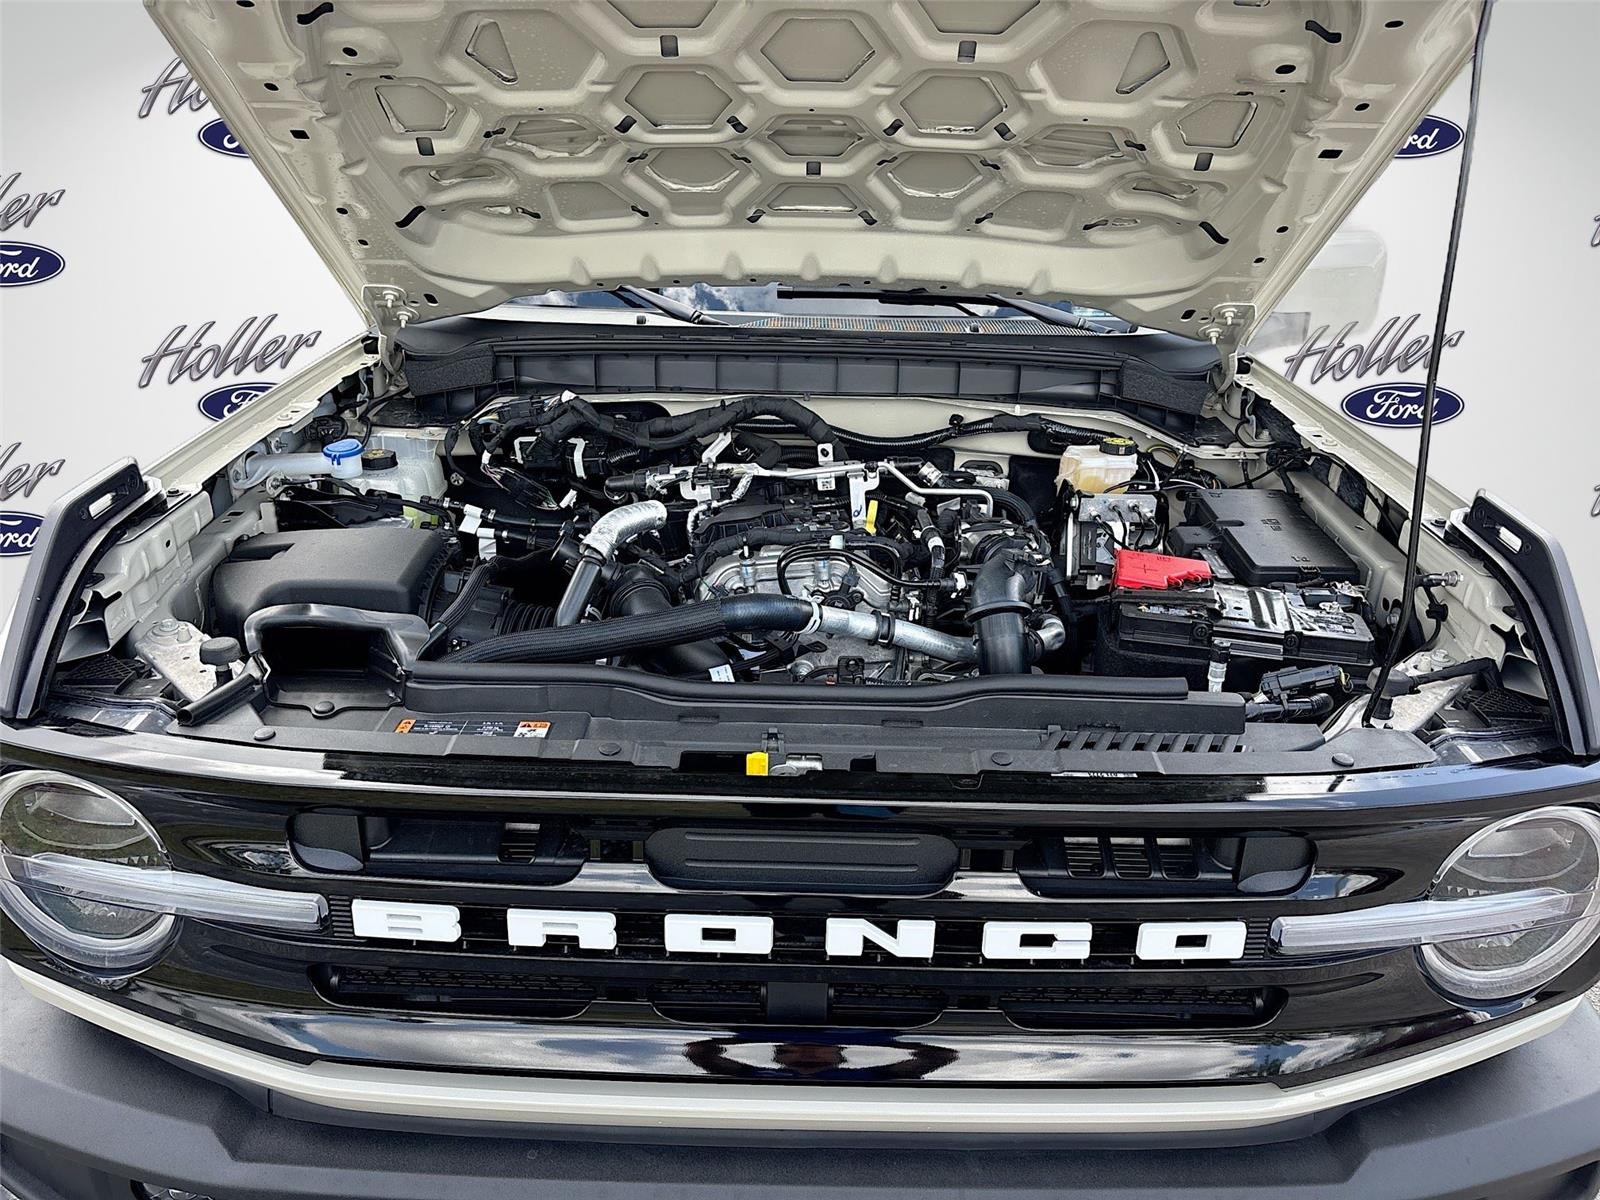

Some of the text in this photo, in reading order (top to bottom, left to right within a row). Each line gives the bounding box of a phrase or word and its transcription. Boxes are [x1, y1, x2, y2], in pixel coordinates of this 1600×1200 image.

[1402, 129, 1440, 150] rd
[138, 313, 322, 389] Holler
[350, 899, 1248, 961] BRONCO
